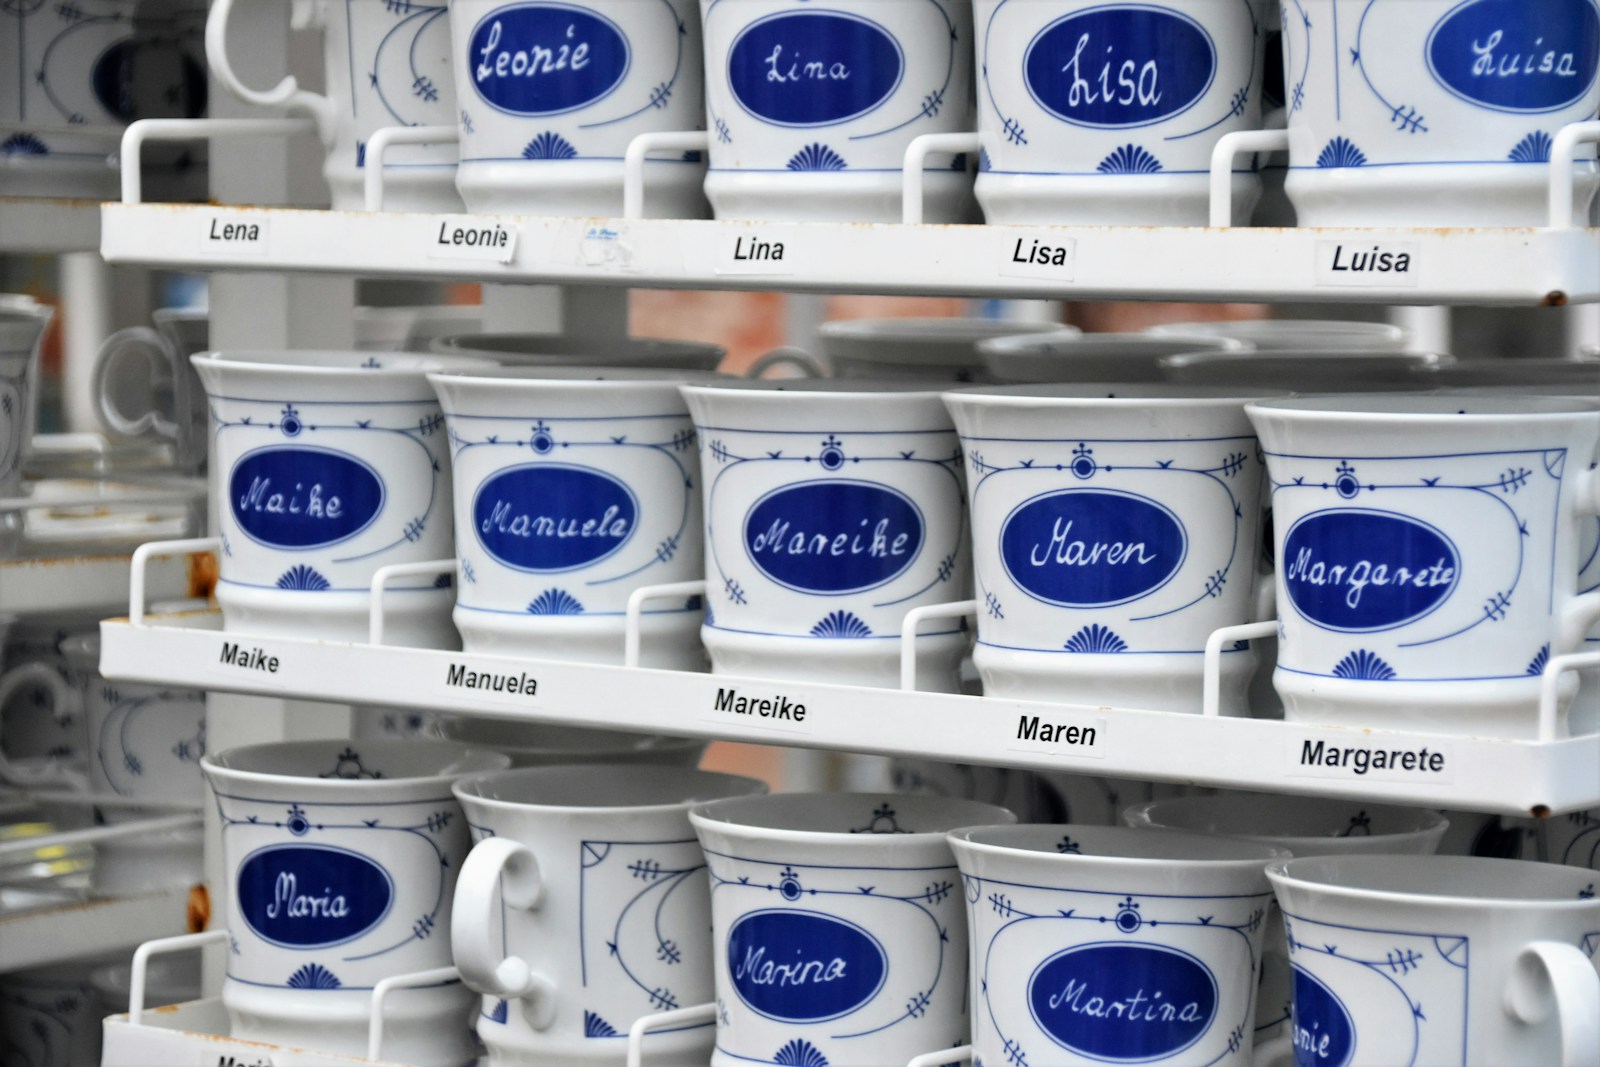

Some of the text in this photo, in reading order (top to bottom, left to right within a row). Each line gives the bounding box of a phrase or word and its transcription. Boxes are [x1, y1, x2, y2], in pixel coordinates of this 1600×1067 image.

[477, 20, 590, 81] Leonie
[764, 44, 850, 82] Lina
[1062, 33, 1162, 107] Lisa
[1471, 30, 1577, 77] Luisa
[209, 219, 260, 241] Lena
[438, 222, 508, 247] Leonie
[734, 237, 784, 261] Lina
[1012, 239, 1067, 266] Lisa
[1331, 246, 1411, 273] Luisa
[240, 476, 342, 517] Maike
[482, 501, 629, 541] Manuela
[753, 517, 909, 557] Mareike
[1030, 517, 1157, 567] Maren
[1288, 546, 1454, 609] Margarete
[220, 643, 279, 673] Maike
[446, 664, 537, 695] Manuela
[715, 688, 806, 722] Mareike
[1017, 715, 1096, 746] Maren
[1300, 740, 1445, 775] Margarete
[267, 872, 347, 919] Maria
[735, 945, 848, 986] Marina
[1049, 978, 1201, 1022] Martina
